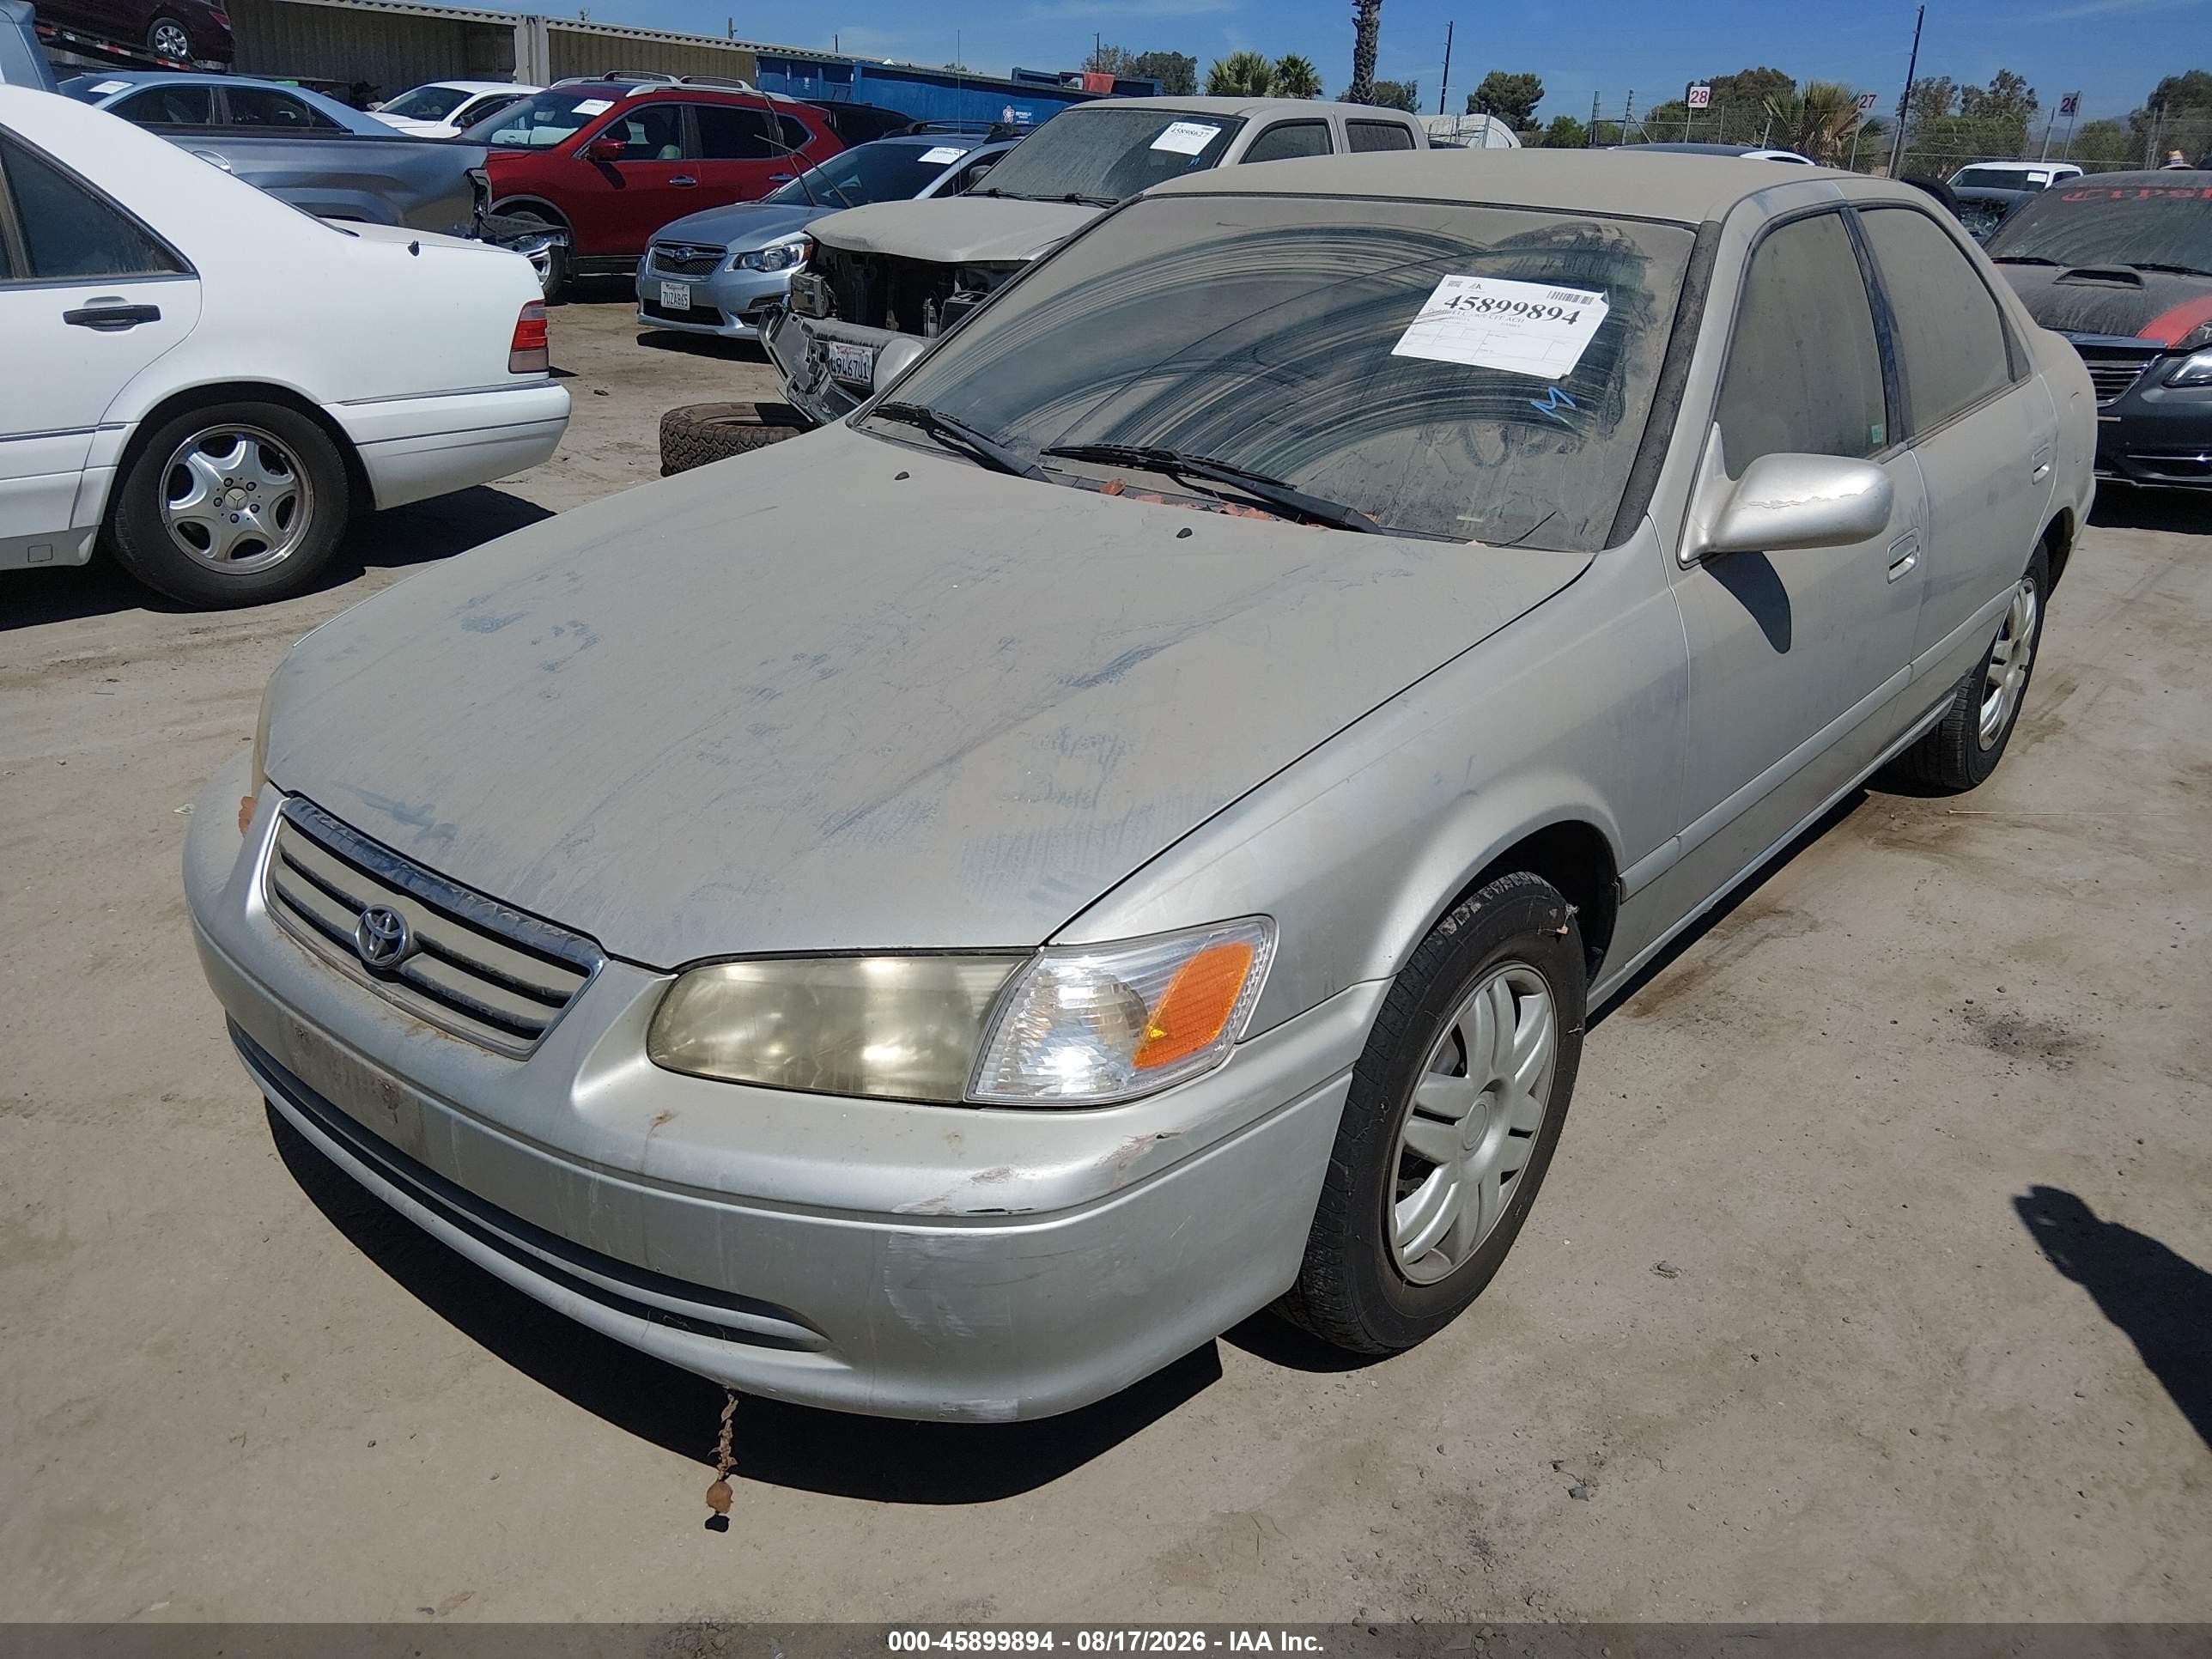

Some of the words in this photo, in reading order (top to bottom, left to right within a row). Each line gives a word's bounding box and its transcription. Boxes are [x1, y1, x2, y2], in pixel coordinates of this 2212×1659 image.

[1689, 90, 1708, 104] 28
[1859, 94, 1877, 109] 27
[1443, 294, 1582, 325] 45899894
[830, 356, 869, 380] 49467U1
